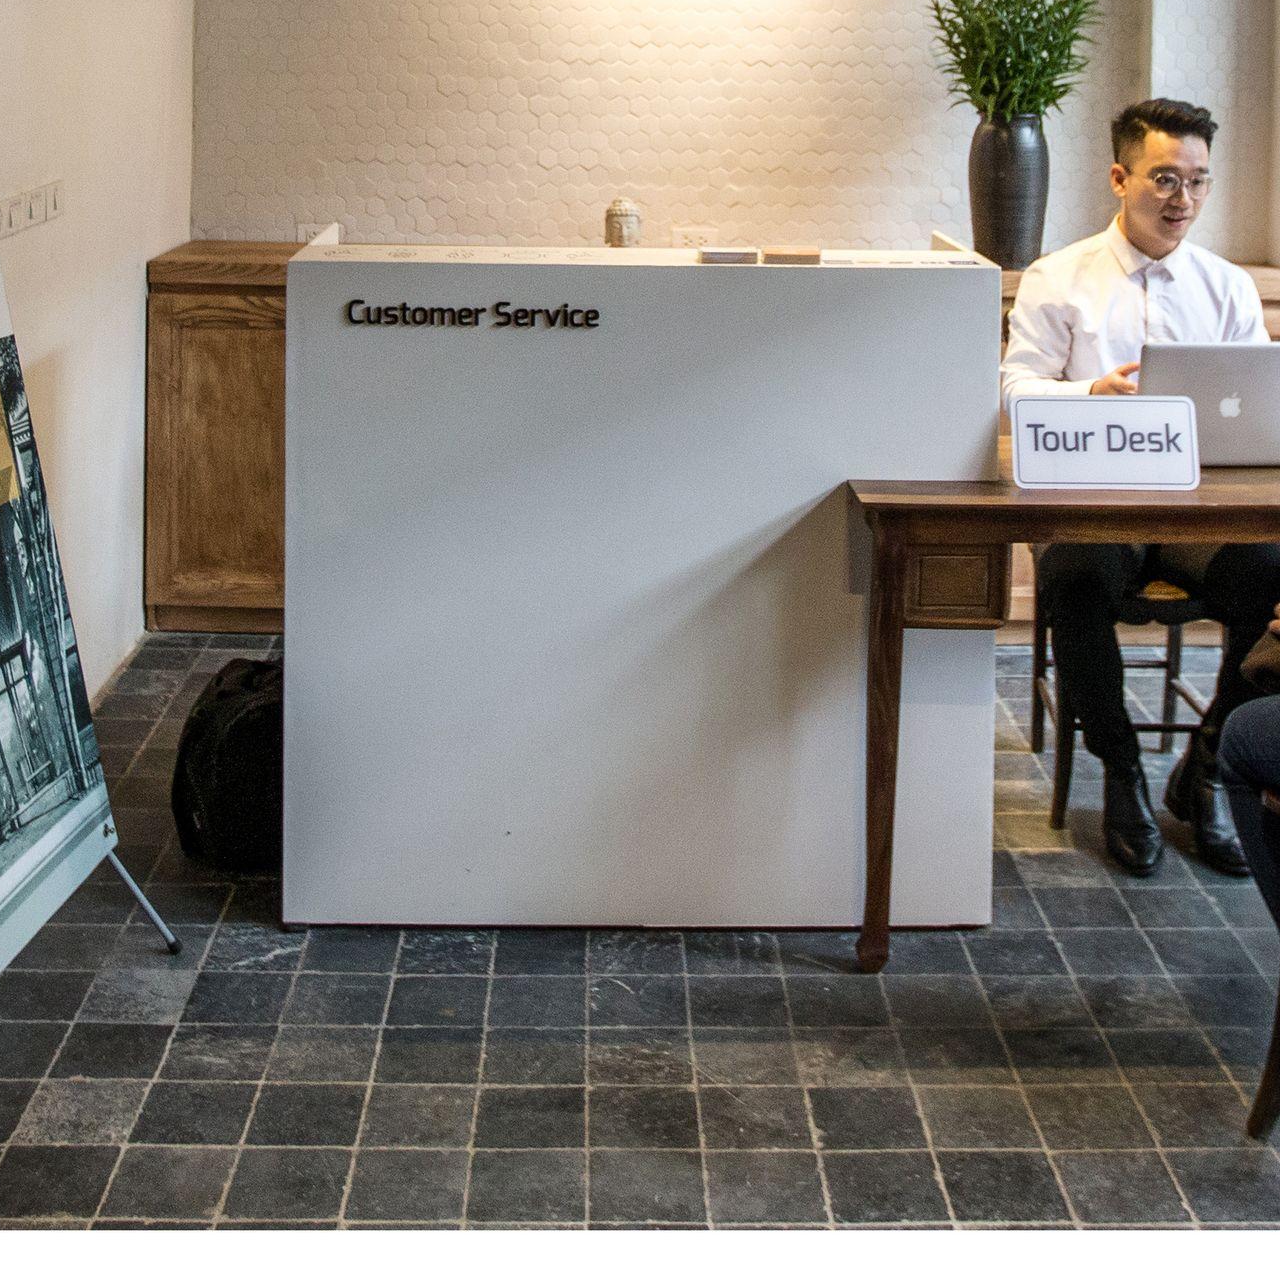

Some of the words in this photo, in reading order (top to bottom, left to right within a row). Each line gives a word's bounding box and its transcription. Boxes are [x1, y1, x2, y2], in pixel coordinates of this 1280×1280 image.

[346, 299, 487, 327] Customer
[492, 301, 600, 328] Service
[1026, 423, 1095, 452] Tour
[1106, 423, 1183, 453] Desk
